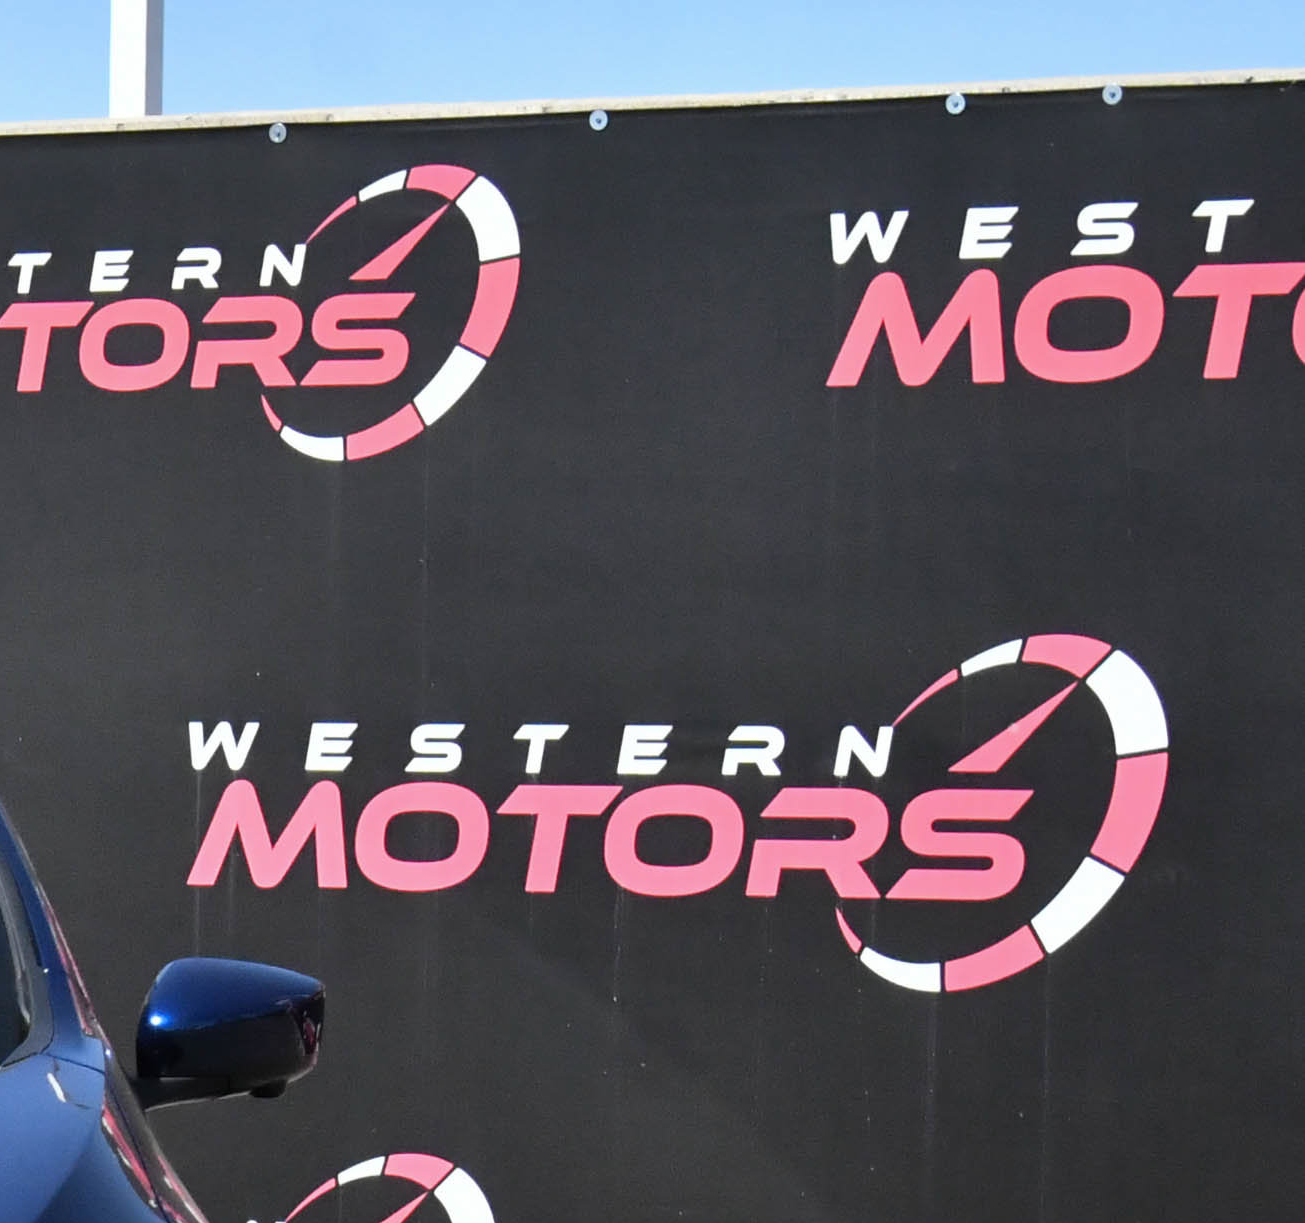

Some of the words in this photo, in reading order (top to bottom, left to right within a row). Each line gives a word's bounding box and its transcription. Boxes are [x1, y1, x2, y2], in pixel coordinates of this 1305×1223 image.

[829, 200, 1254, 264] WEST
[826, 262, 1305, 388] MOT
[188, 720, 894, 778] WESTERN
[188, 779, 1035, 901] MOTORS
